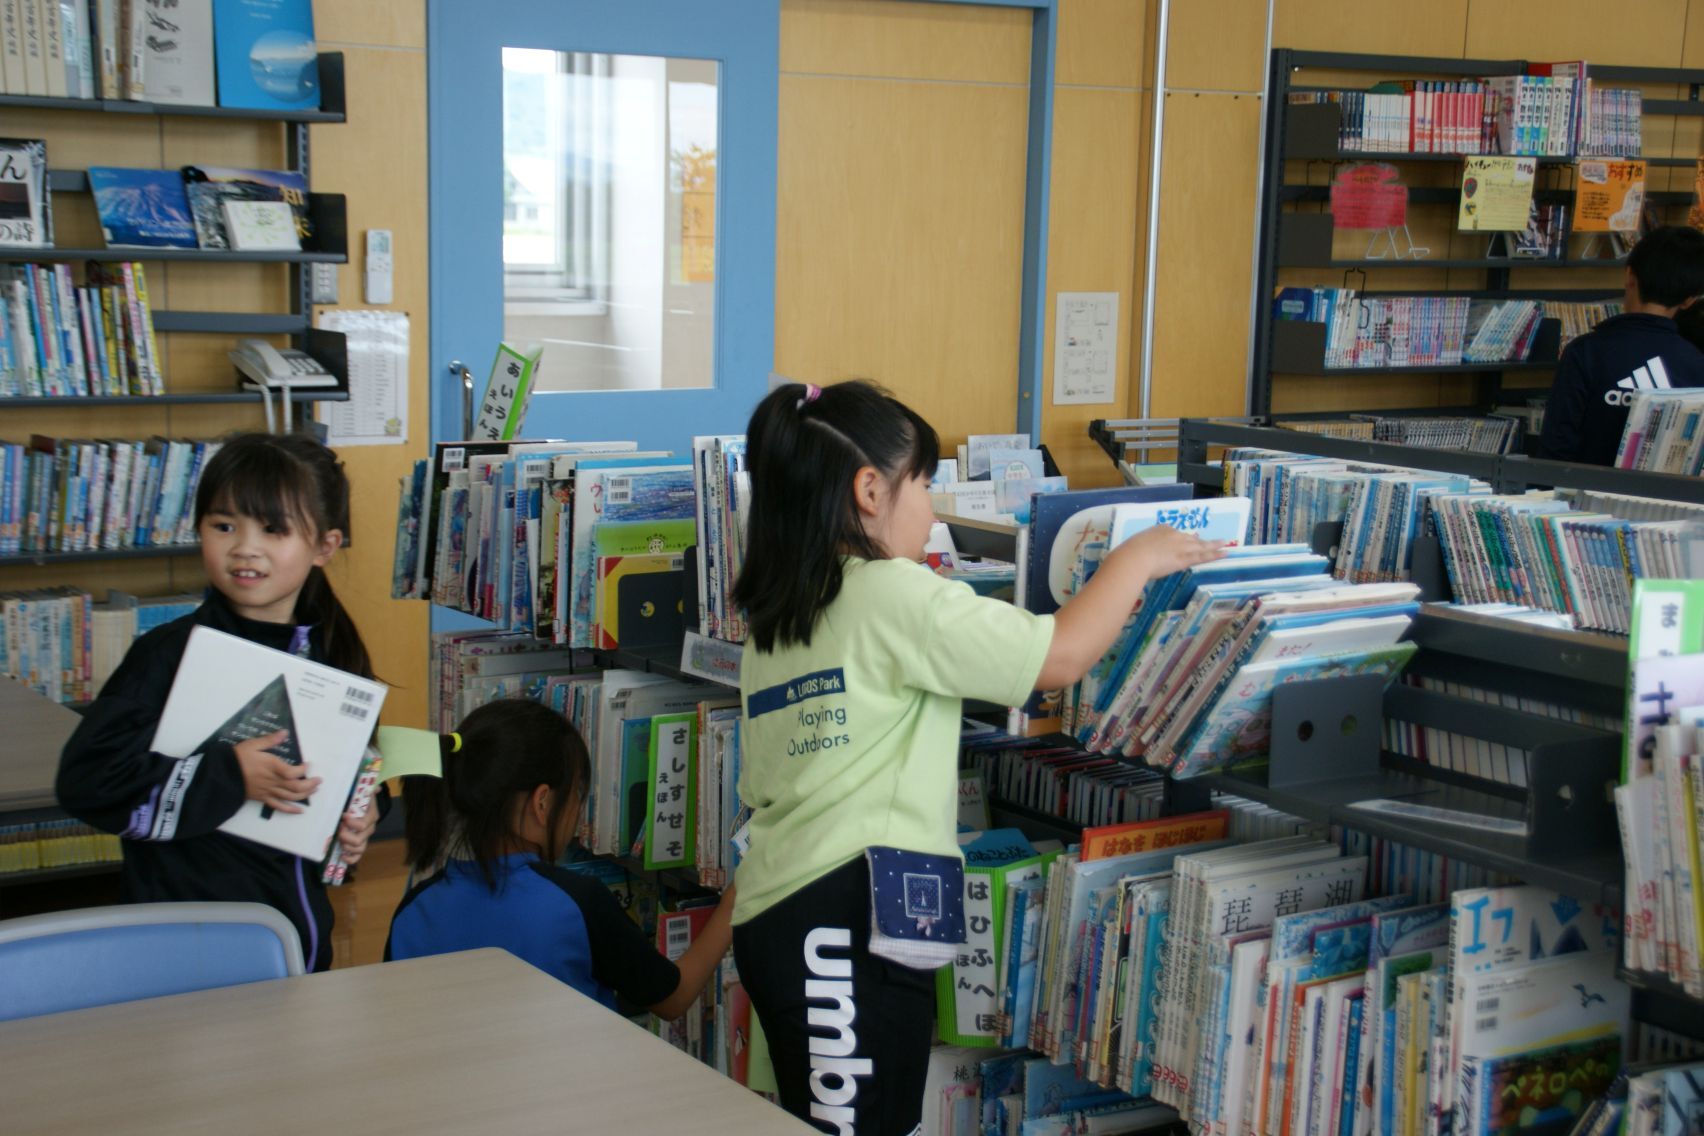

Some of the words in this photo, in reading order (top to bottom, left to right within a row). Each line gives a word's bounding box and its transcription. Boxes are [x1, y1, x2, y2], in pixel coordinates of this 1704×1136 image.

[819, 674, 841, 691] Park
[797, 705, 847, 729] laying
[656, 772, 669, 824] えほん
[666, 727, 687, 857] さしすせそ
[955, 952, 973, 991] ほん
[967, 880, 998, 1033] はひふへほ
